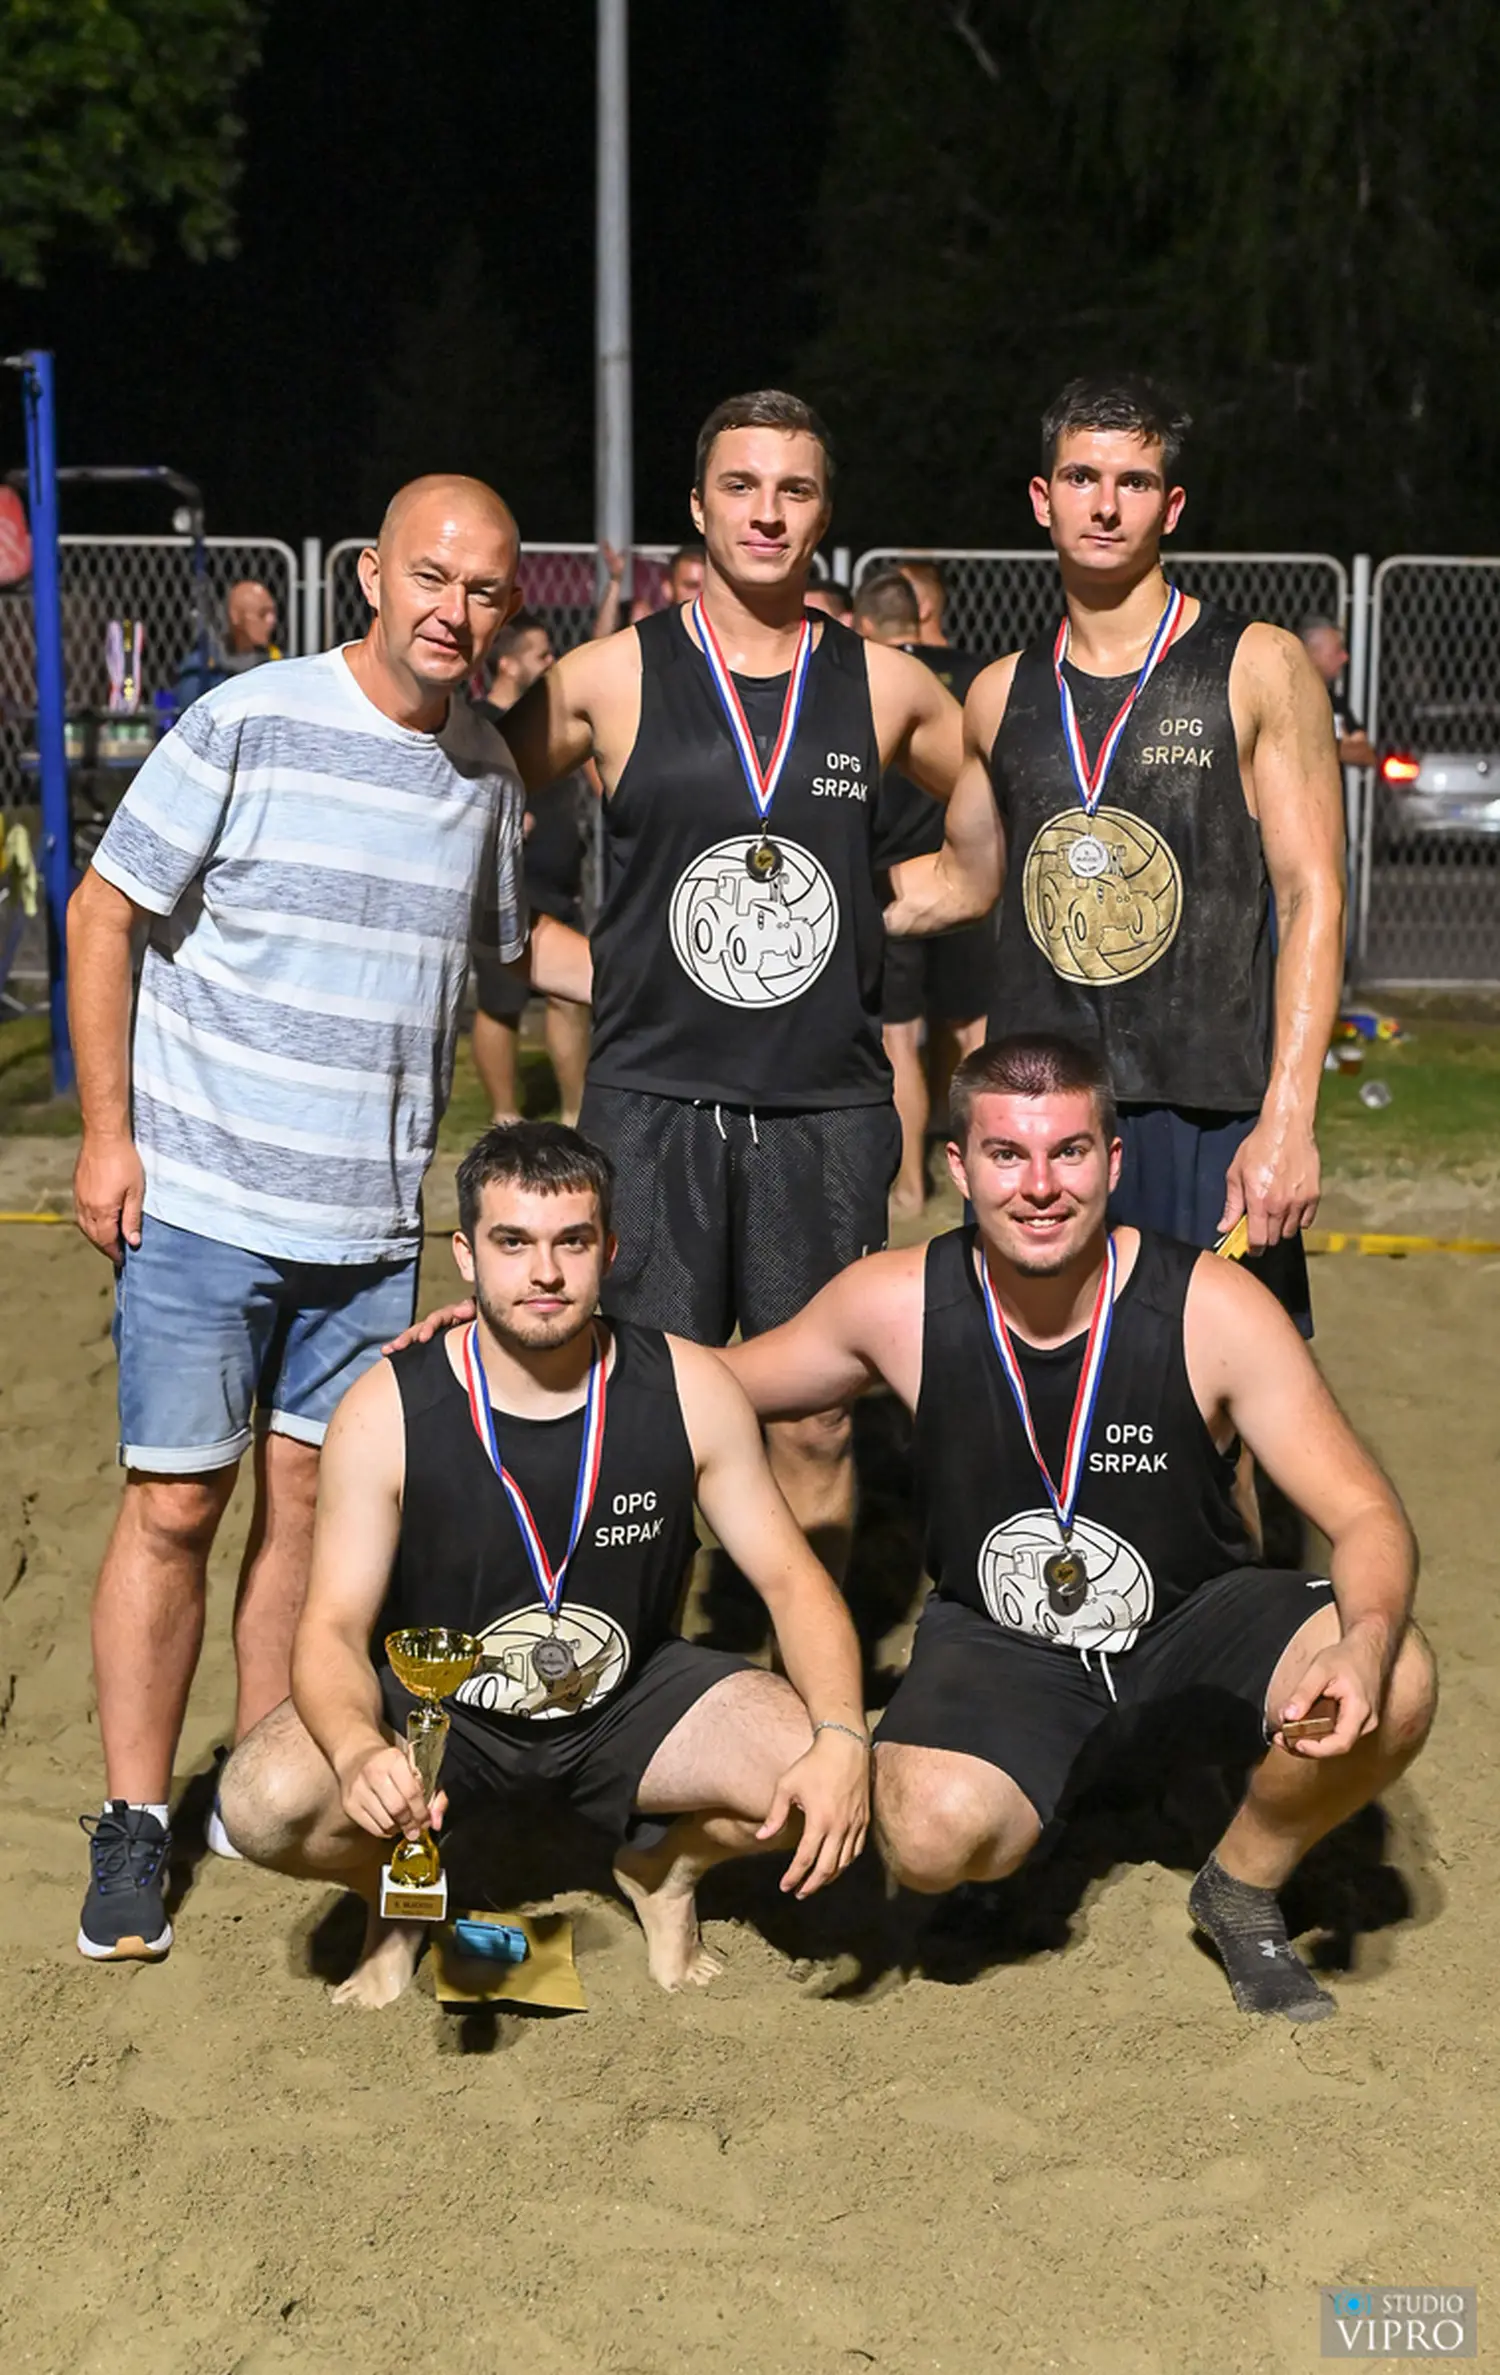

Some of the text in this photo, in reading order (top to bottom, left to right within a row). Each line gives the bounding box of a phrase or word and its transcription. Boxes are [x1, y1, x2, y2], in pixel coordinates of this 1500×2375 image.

[1160, 718, 1204, 737] OPG
[826, 752, 861, 773] OPG
[1141, 744, 1214, 769] SRPAK
[811, 777, 868, 802] SRPAK
[1106, 1423, 1153, 1444] OPG
[1088, 1452, 1168, 1473] SRPAK
[612, 1491, 657, 1515] OPG
[594, 1517, 664, 1547] SRPAK
